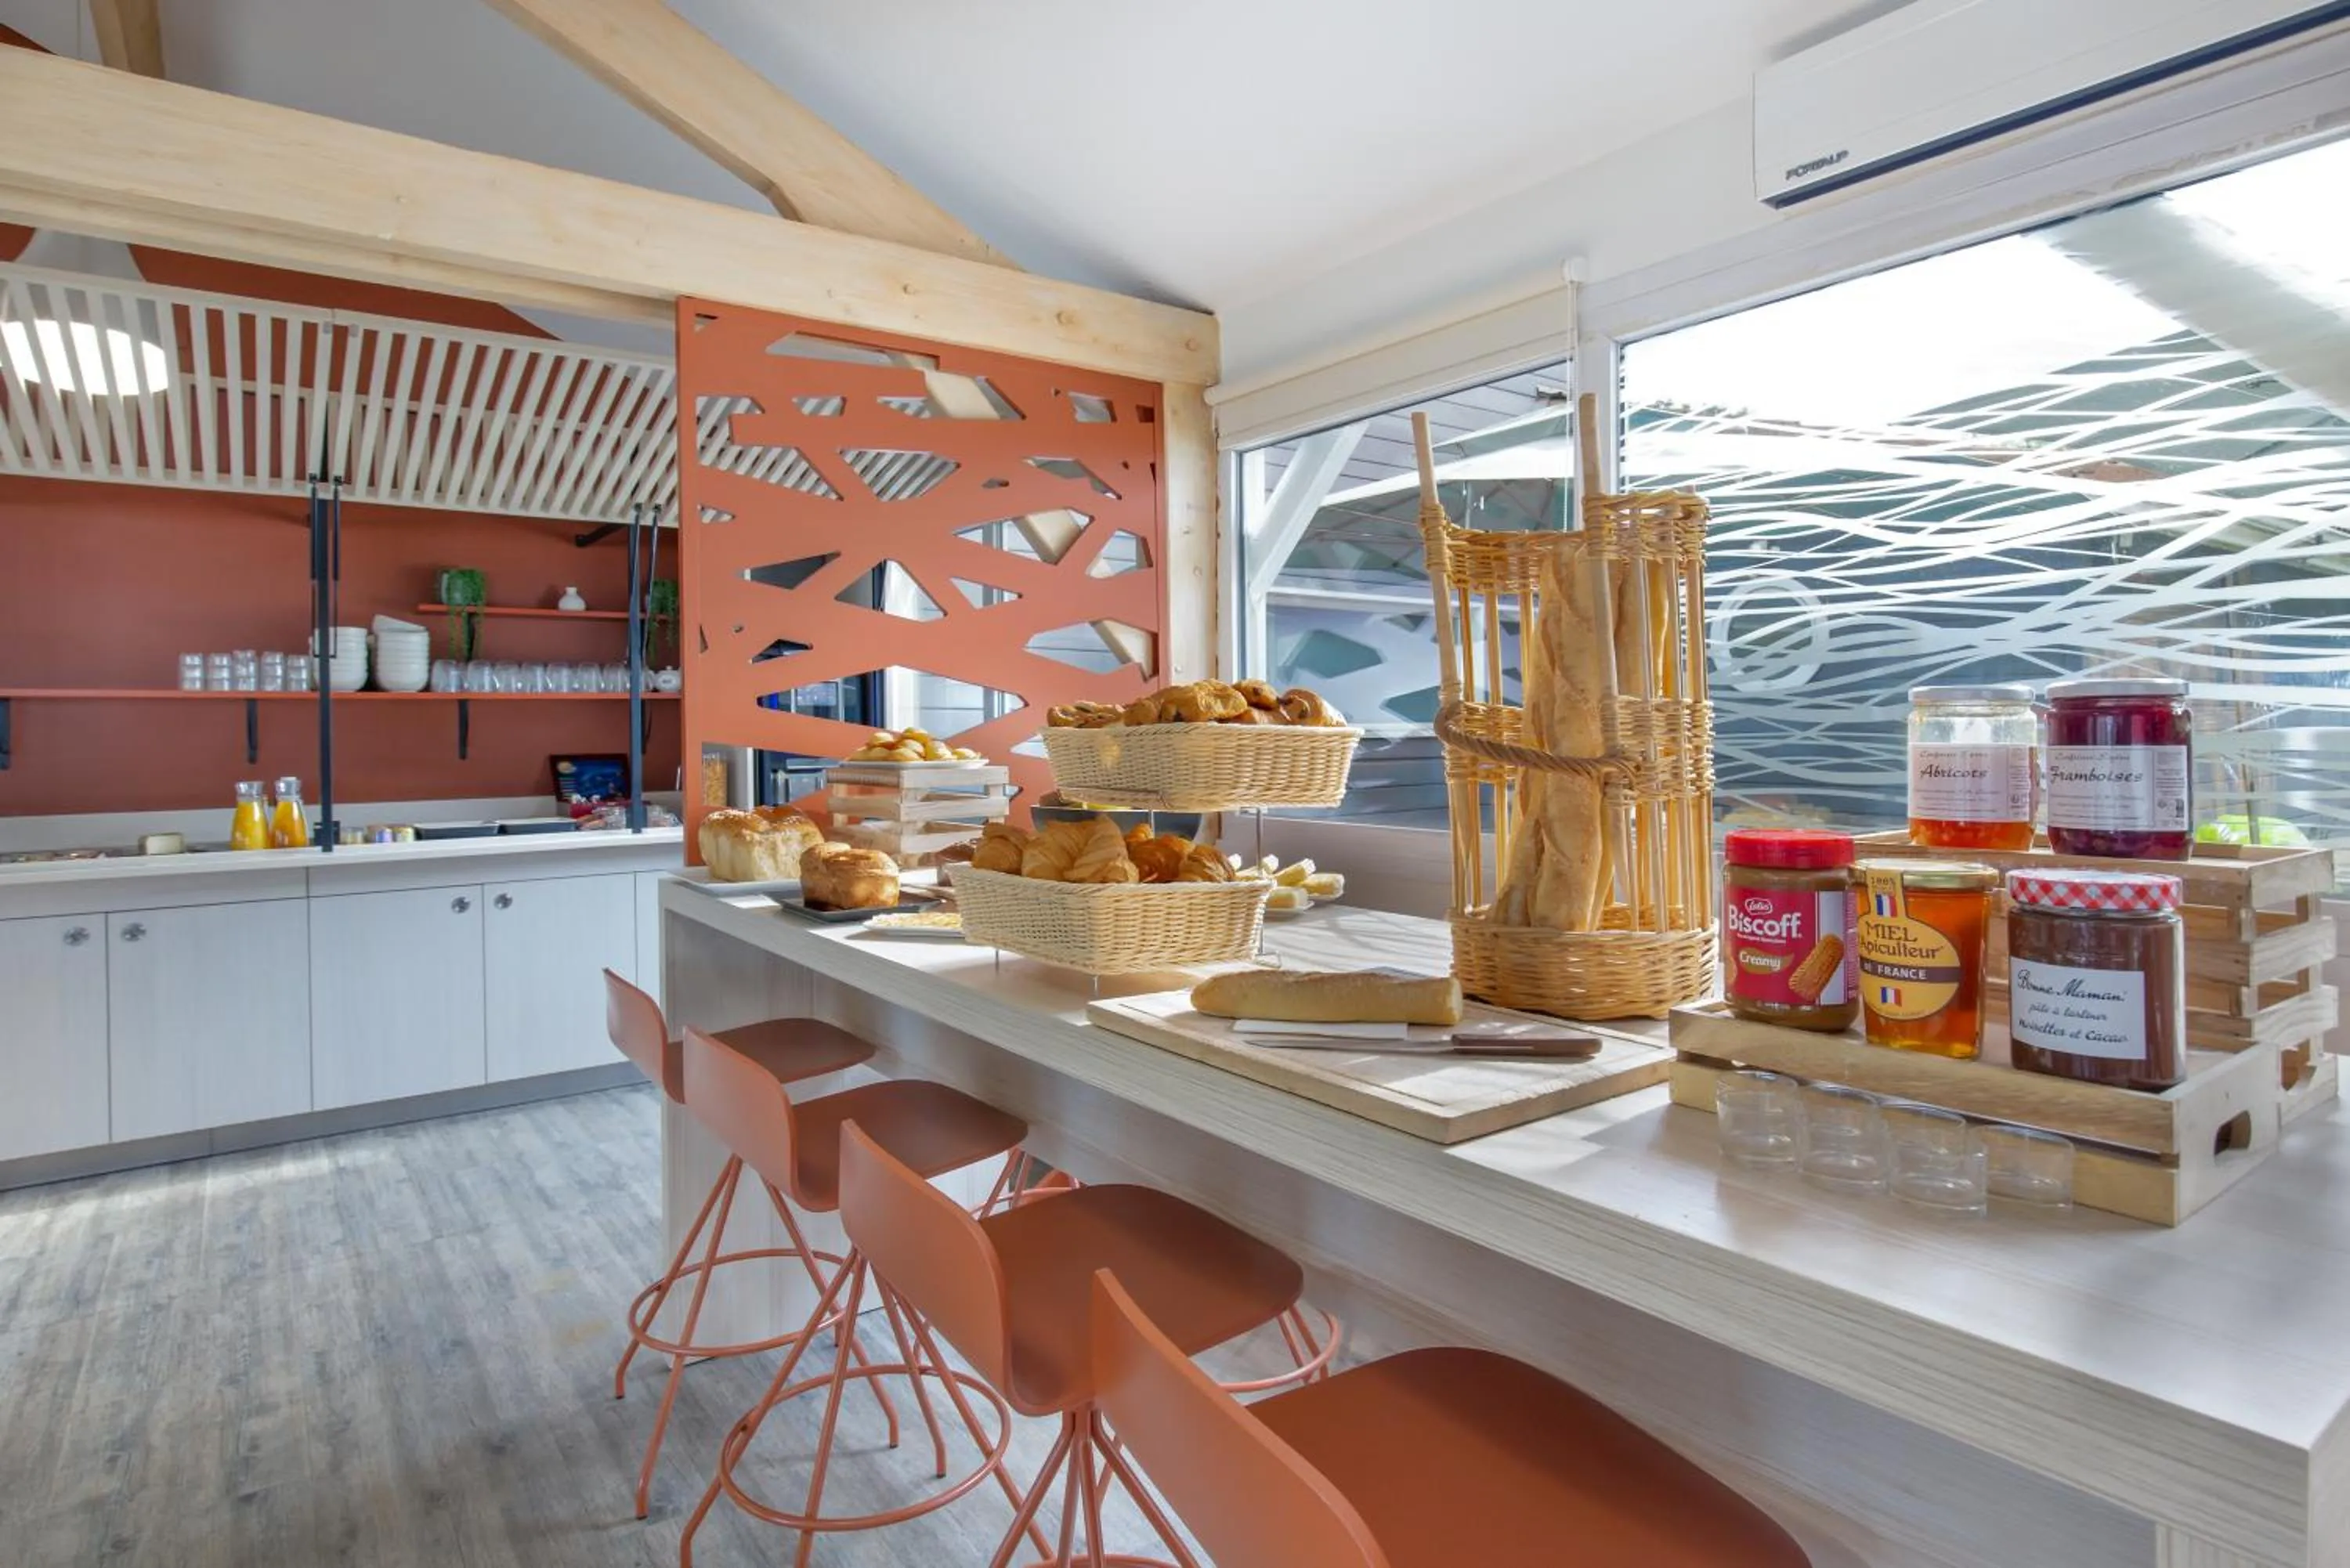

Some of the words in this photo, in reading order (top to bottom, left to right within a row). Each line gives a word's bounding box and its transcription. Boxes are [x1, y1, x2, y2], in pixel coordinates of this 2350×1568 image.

[2050, 765, 2144, 784] Framboises
[1729, 904, 1802, 938] Biscoff
[1865, 920, 1918, 942] MIEL
[1740, 950, 1781, 972] Creamy
[1878, 964, 1928, 980] FRANCE
[2017, 968, 2054, 995] Bonne
[2055, 978, 2124, 1002] Maman
[2084, 1030, 2130, 1042] Cacao
